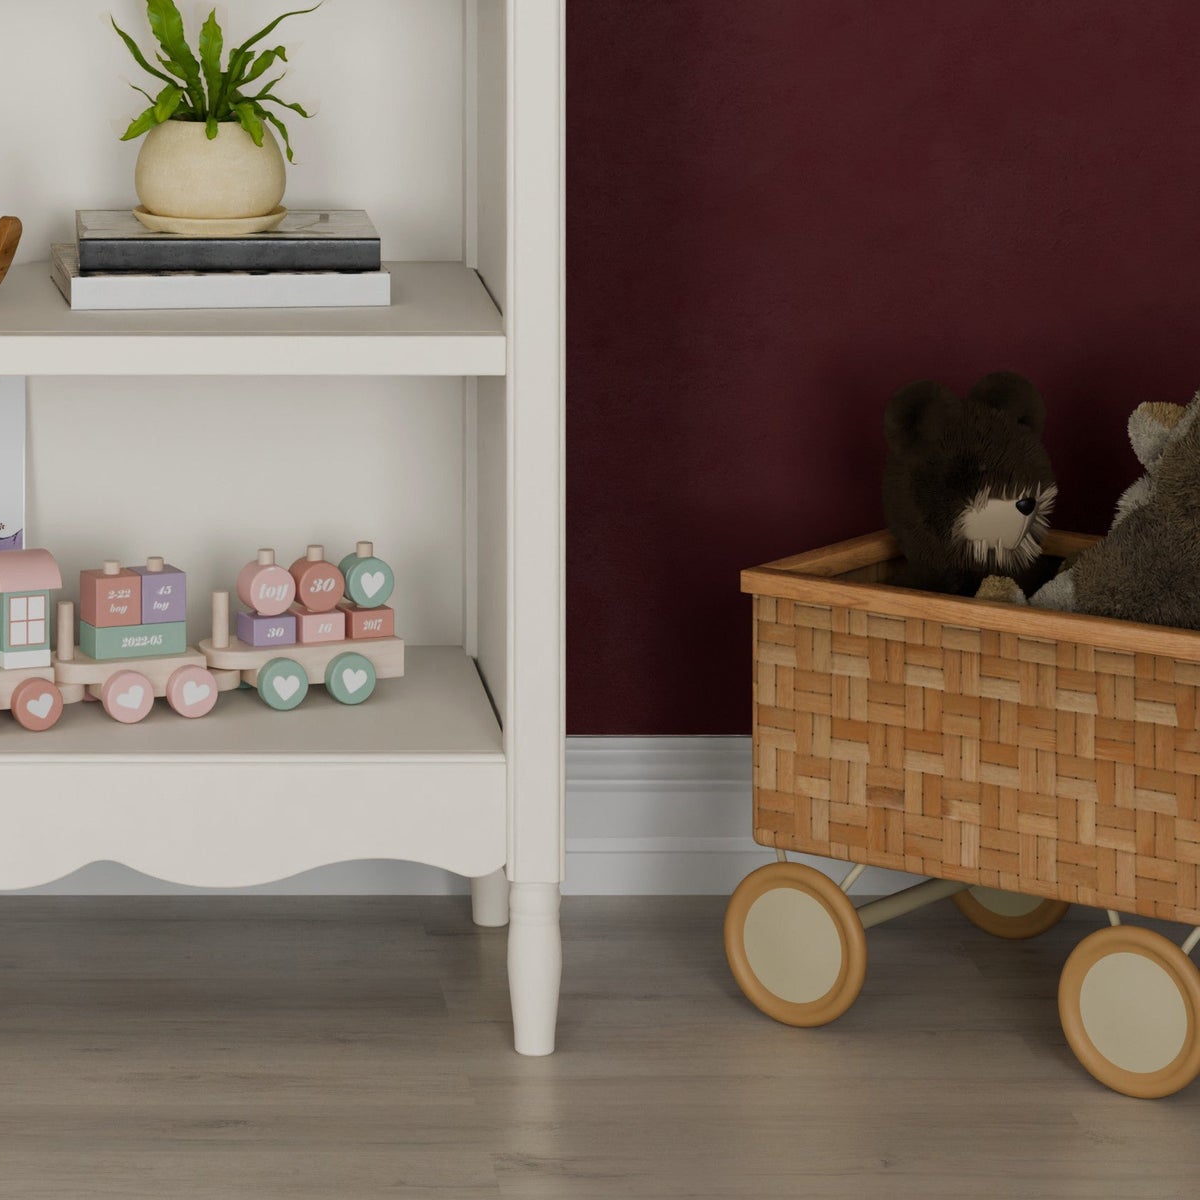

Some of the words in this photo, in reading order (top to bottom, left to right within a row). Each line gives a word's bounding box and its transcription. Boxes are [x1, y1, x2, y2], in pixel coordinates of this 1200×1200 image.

[310, 577, 336, 593] 30
[108, 589, 131, 599] 2-22
[258, 583, 289, 602] toy
[317, 623, 333, 634] 16
[363, 619, 383, 631] 2017
[267, 627, 284, 638] 30
[121, 635, 163, 648] 2022-05
